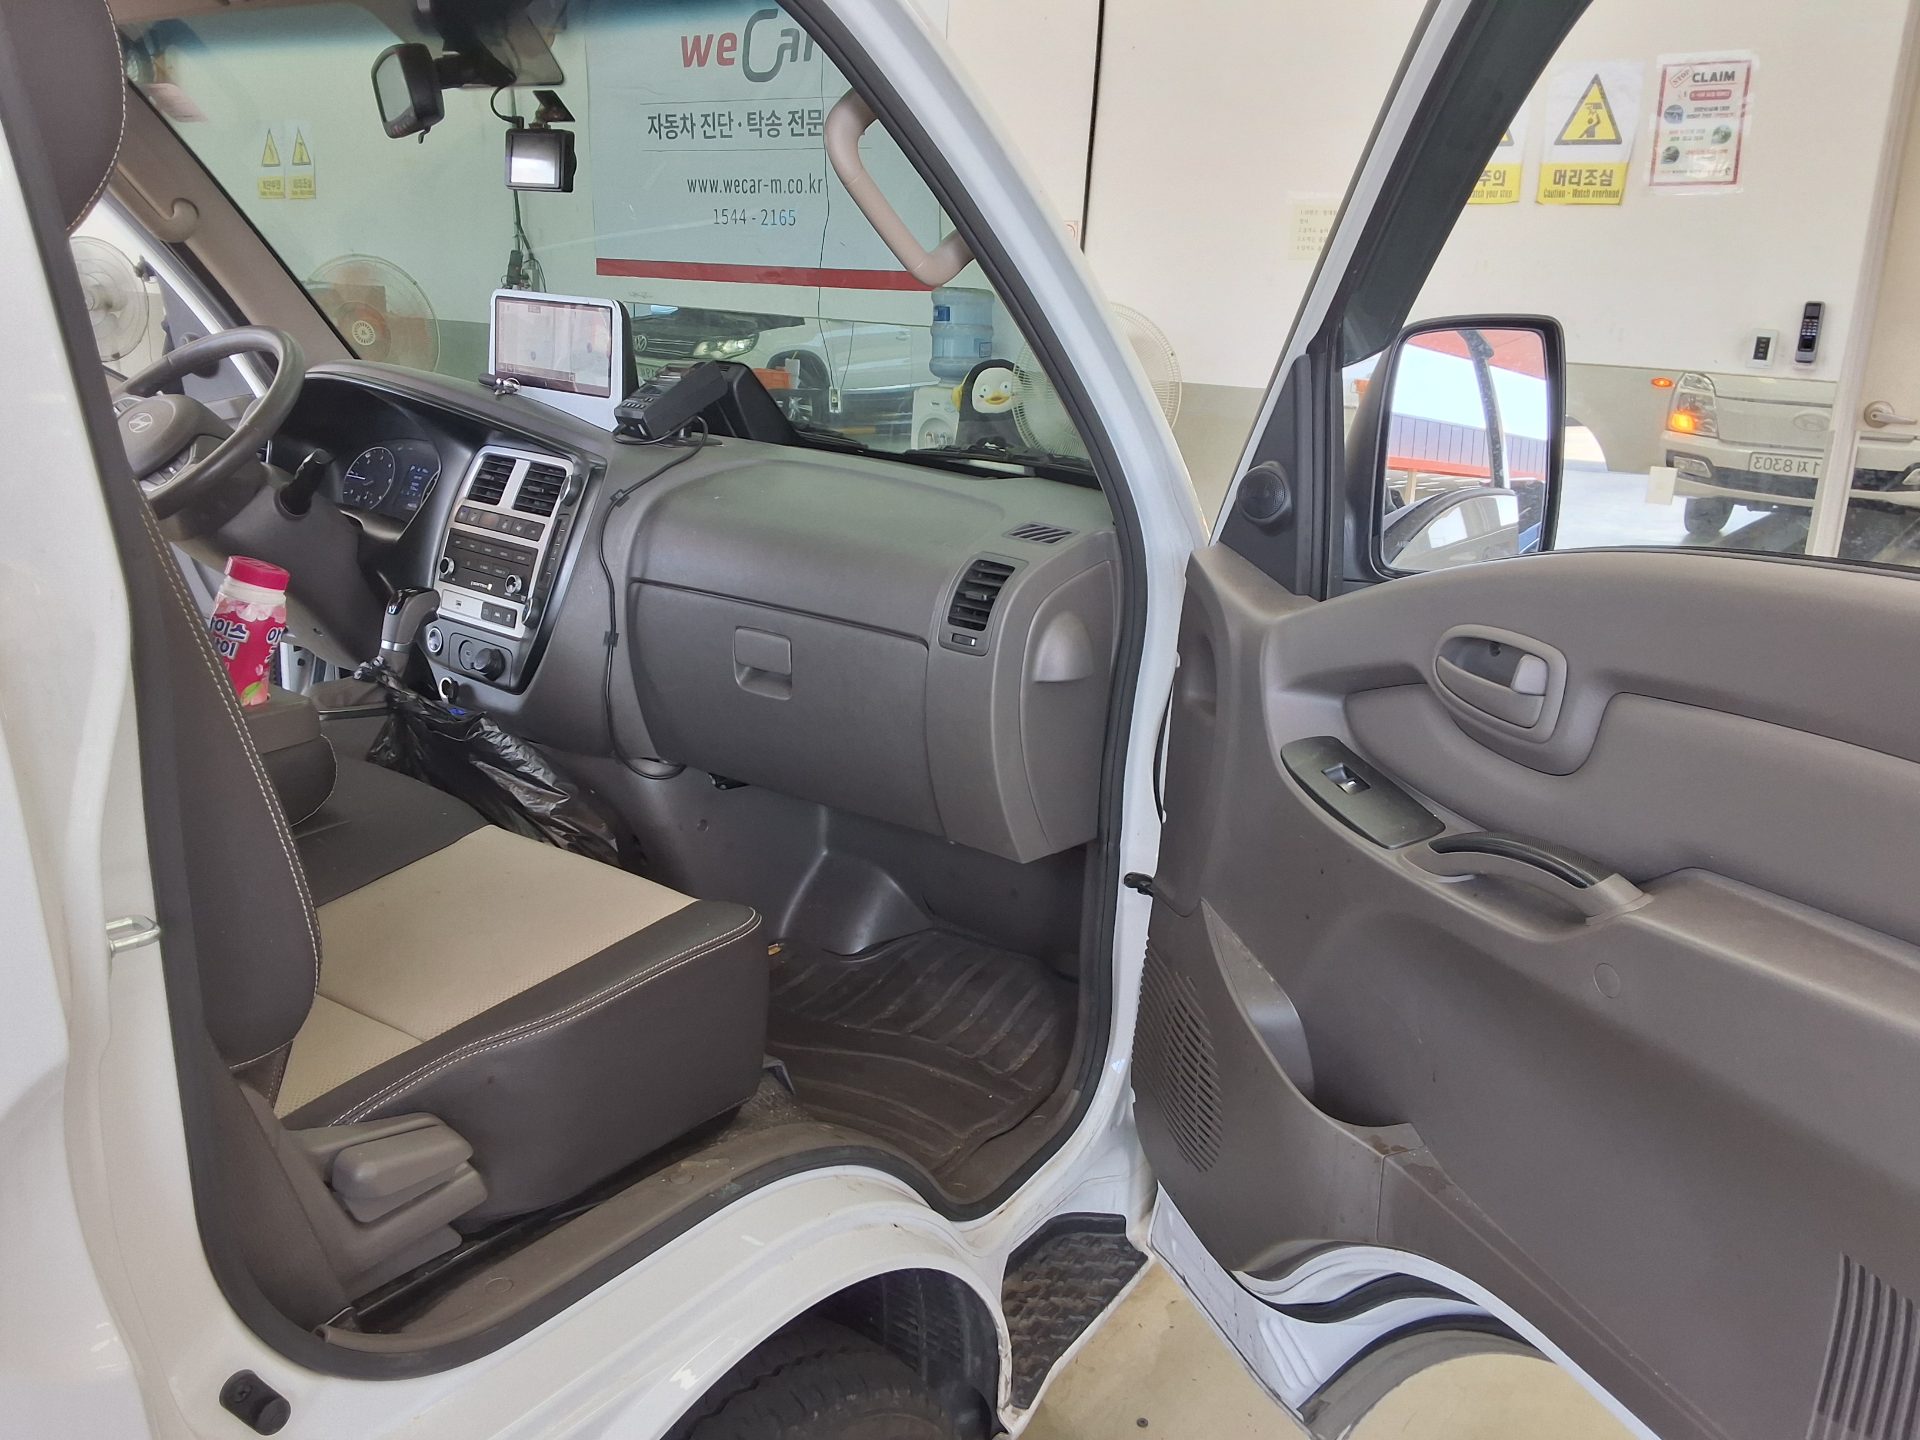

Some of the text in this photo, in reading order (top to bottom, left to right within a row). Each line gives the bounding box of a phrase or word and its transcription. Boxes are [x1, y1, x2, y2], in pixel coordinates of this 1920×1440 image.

[1692, 71, 1736, 83] CLAIM
[648, 112, 696, 140] 자동차
[787, 109, 823, 137] 전문
[687, 173, 822, 195] www.wecar-m.co.kr
[1553, 169, 1613, 187] 머리조심
[1543, 189, 1566, 199] Caution
[1572, 189, 1590, 199] Watch
